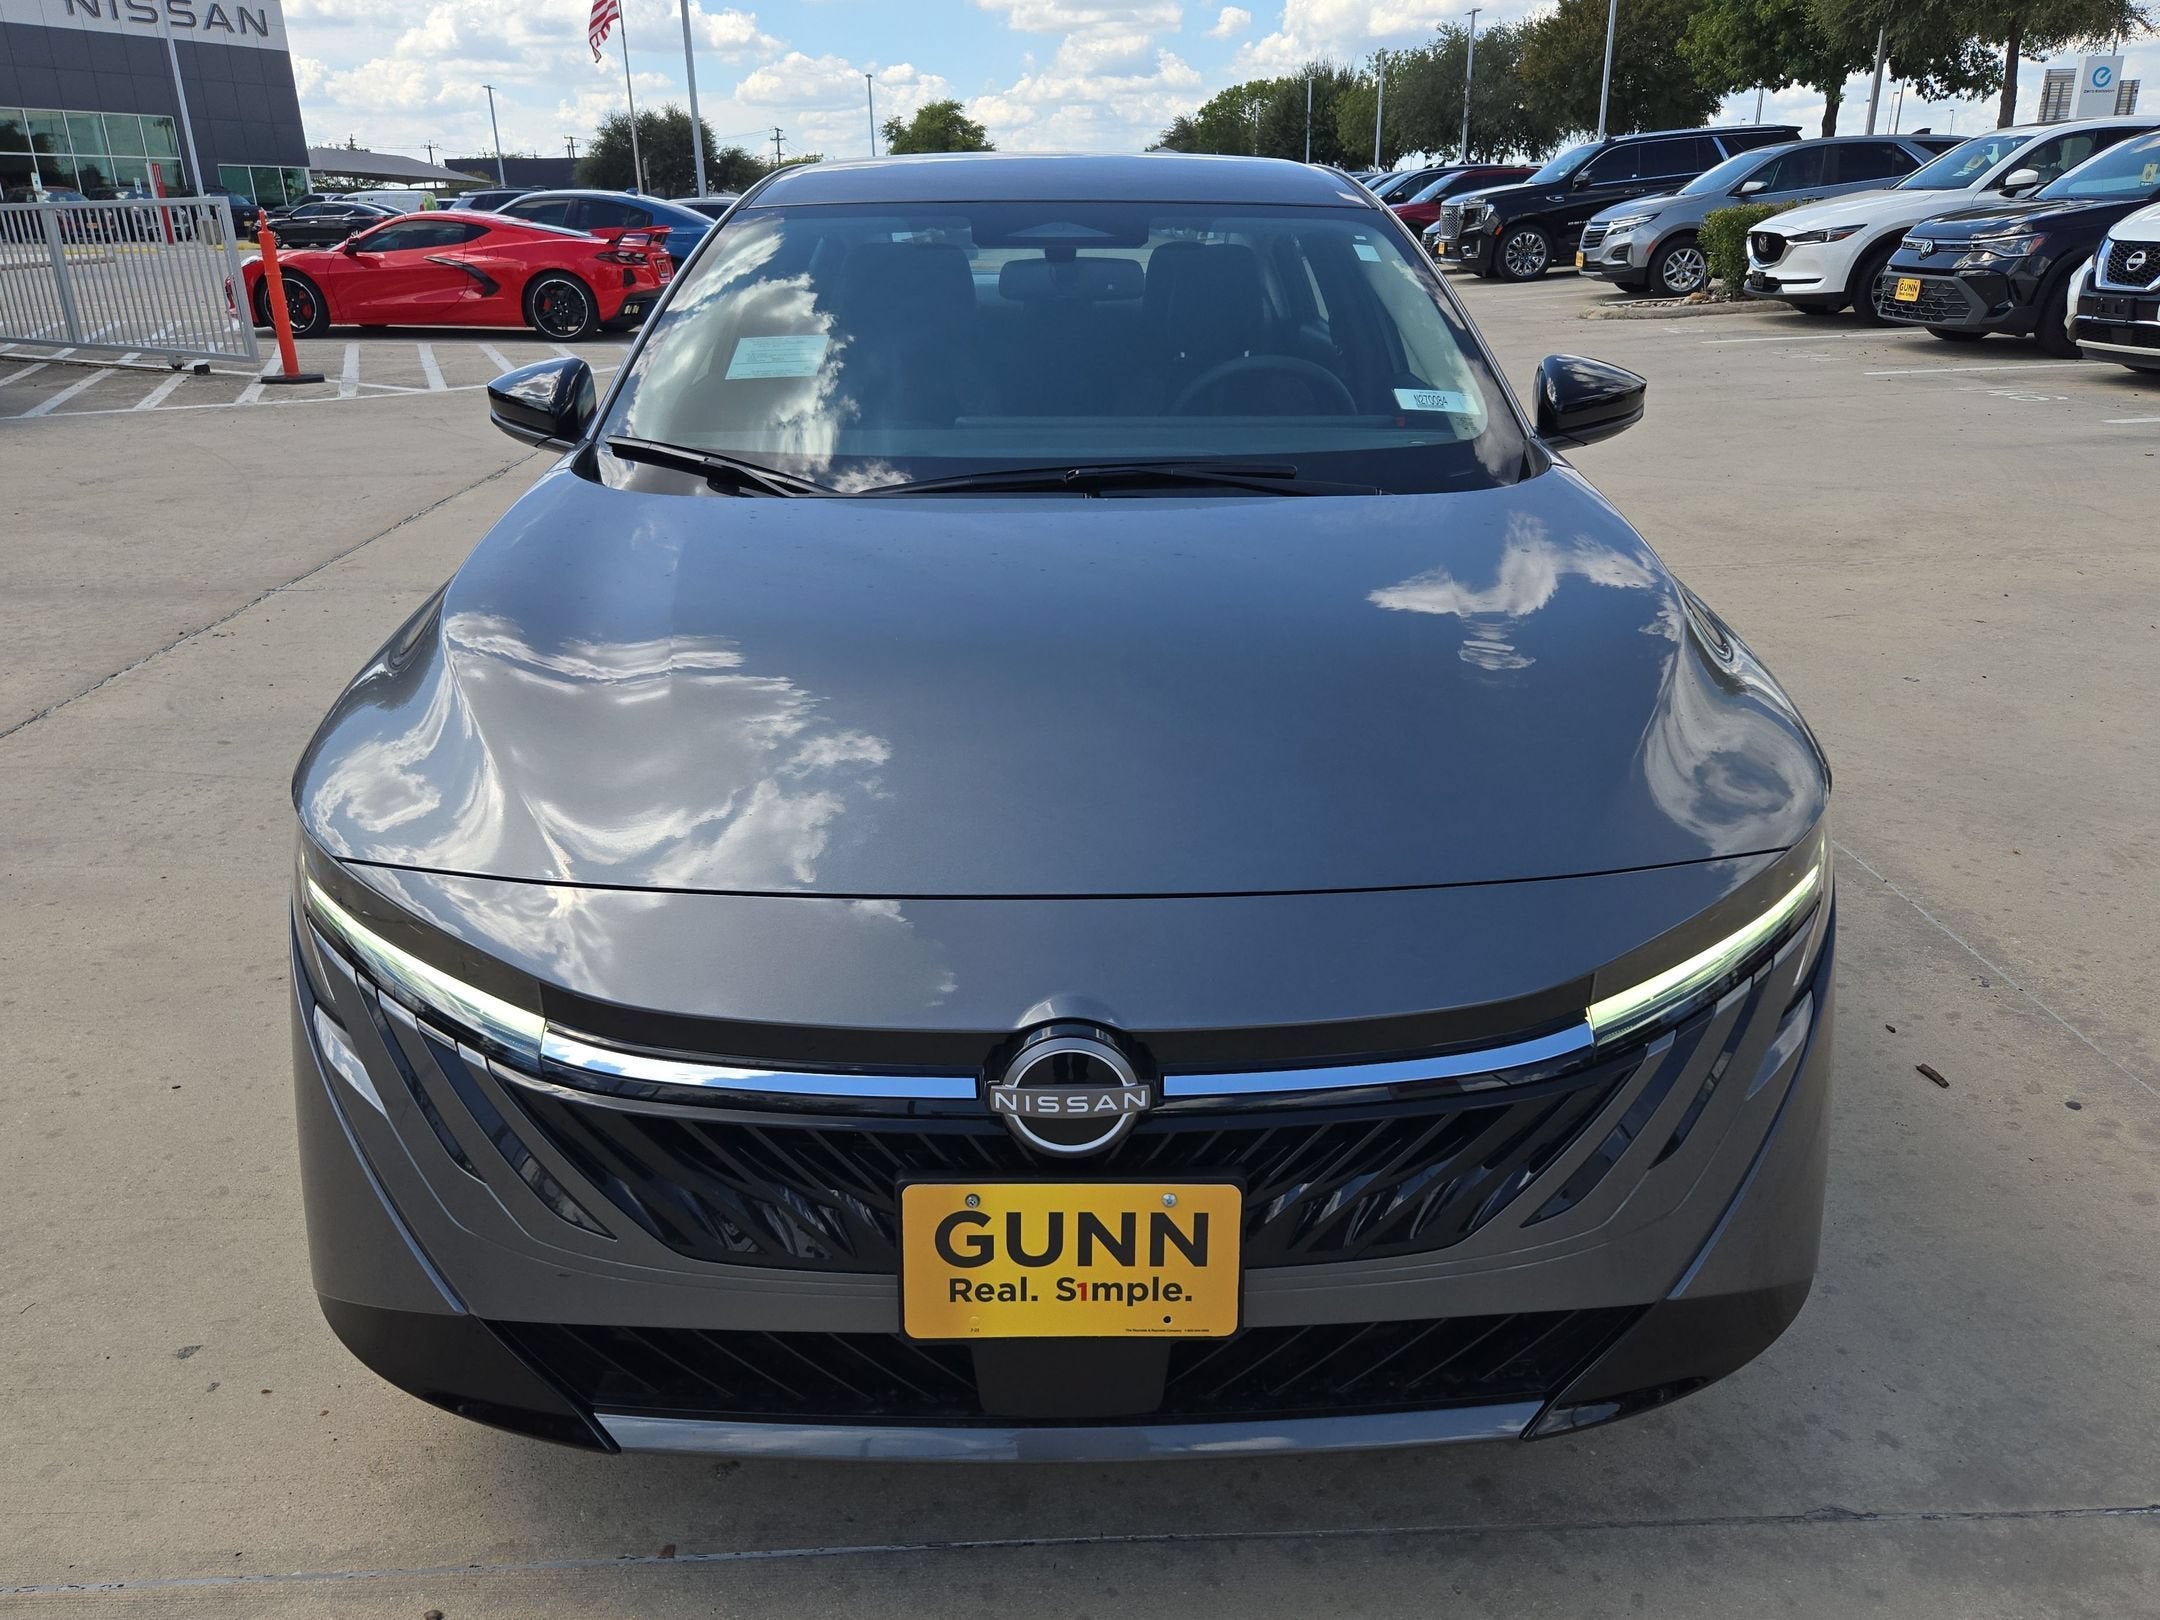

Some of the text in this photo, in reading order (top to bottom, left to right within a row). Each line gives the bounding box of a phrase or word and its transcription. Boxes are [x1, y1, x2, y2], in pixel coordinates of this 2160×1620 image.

[1899, 282, 1918, 292] GUNN
[994, 1090, 1146, 1113] NISSAN
[934, 1210, 1209, 1268] GUNN
[949, 1276, 1193, 1307] Real. S1mple.
